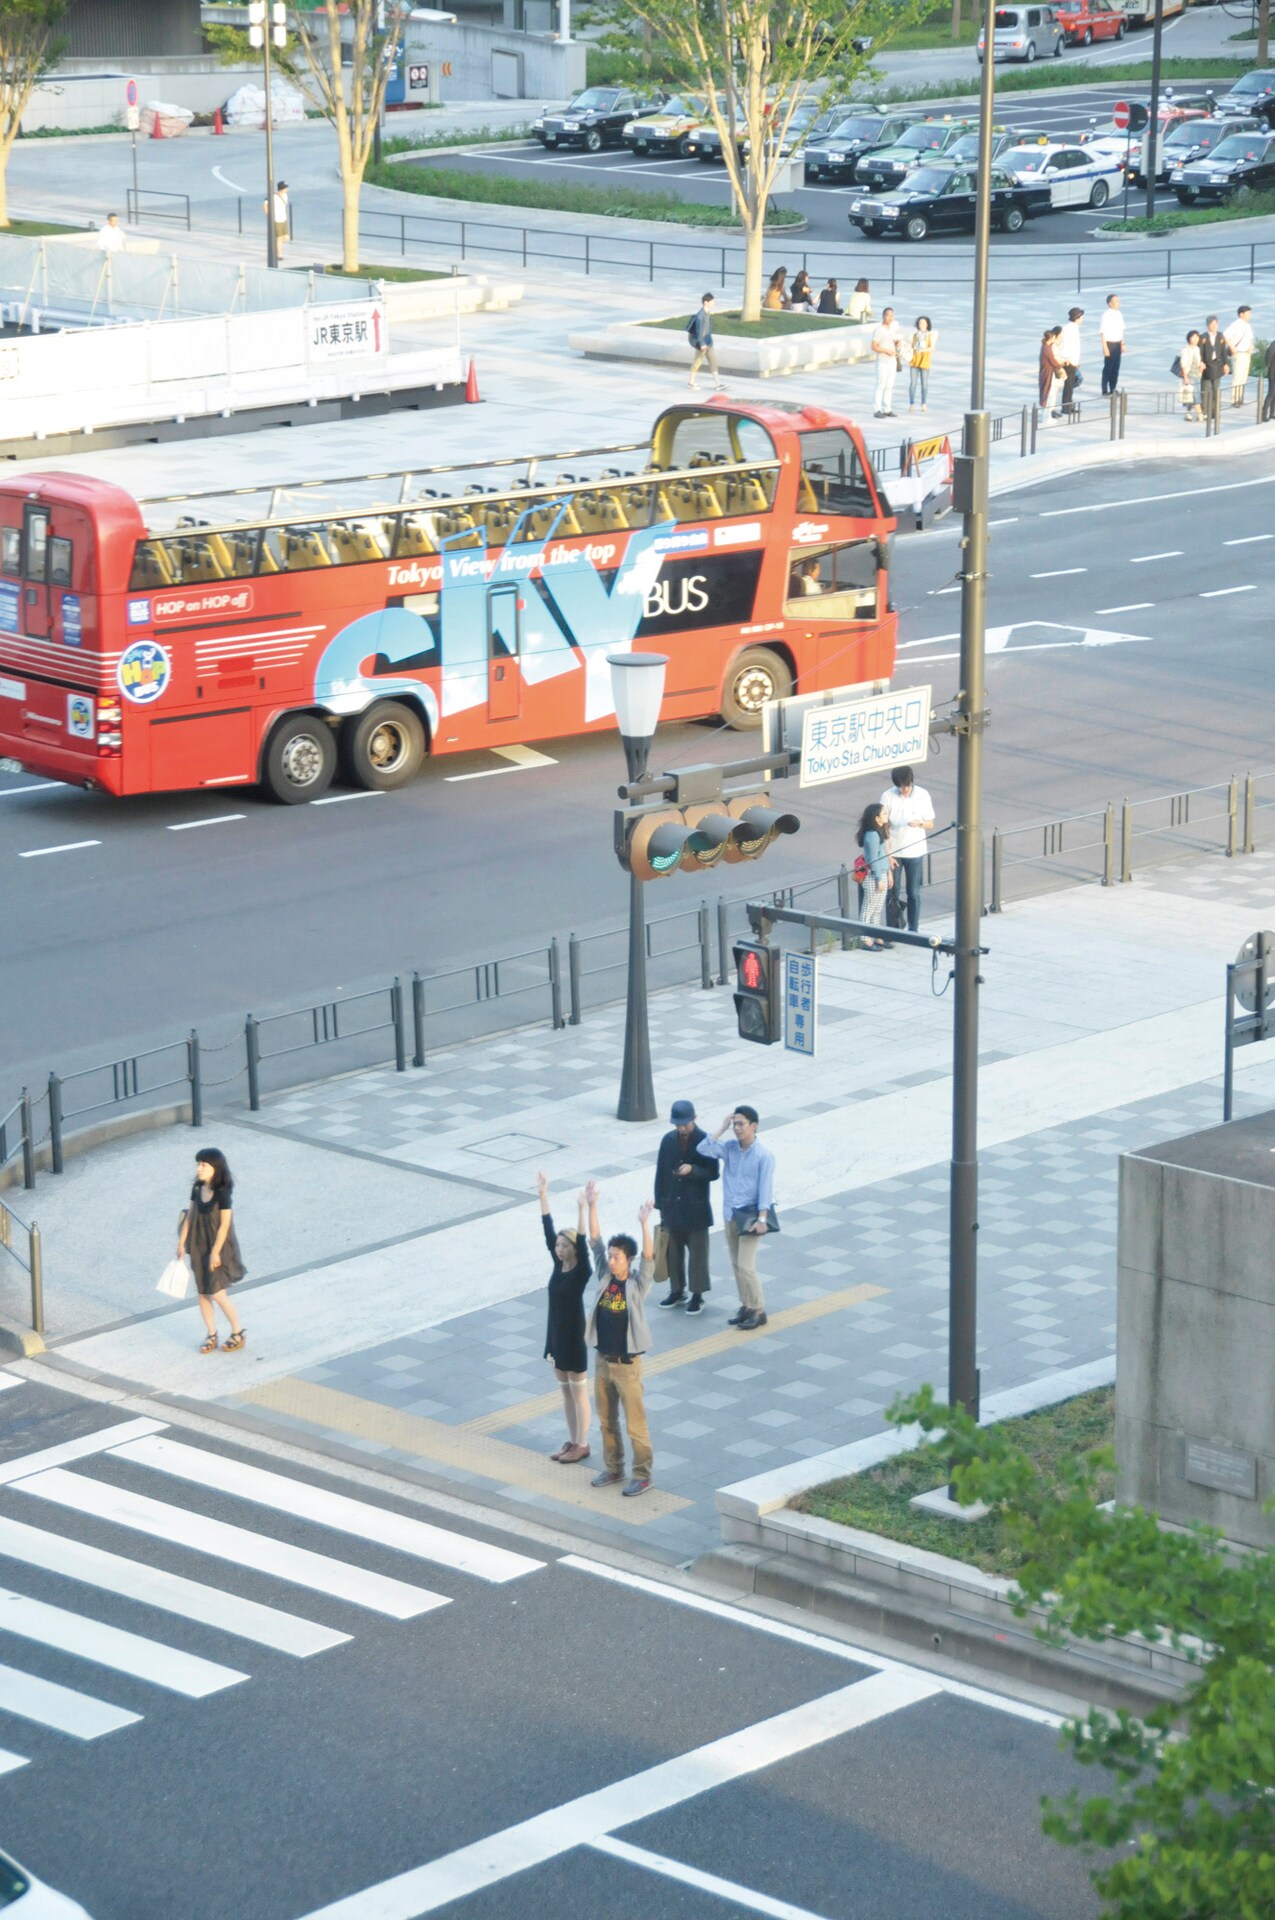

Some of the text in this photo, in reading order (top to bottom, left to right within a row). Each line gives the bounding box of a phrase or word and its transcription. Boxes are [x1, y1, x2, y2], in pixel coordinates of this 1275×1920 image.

[313, 321, 368, 345] JR東京駅
[388, 543, 615, 588] Tokyo View from the top
[156, 592, 249, 615] HOP on HOP off
[642, 575, 709, 619] BUS
[122, 660, 167, 686] HOP
[809, 701, 921, 752] 東京駅中央口
[807, 735, 922, 774] Tokyo Sta Chuoguchi
